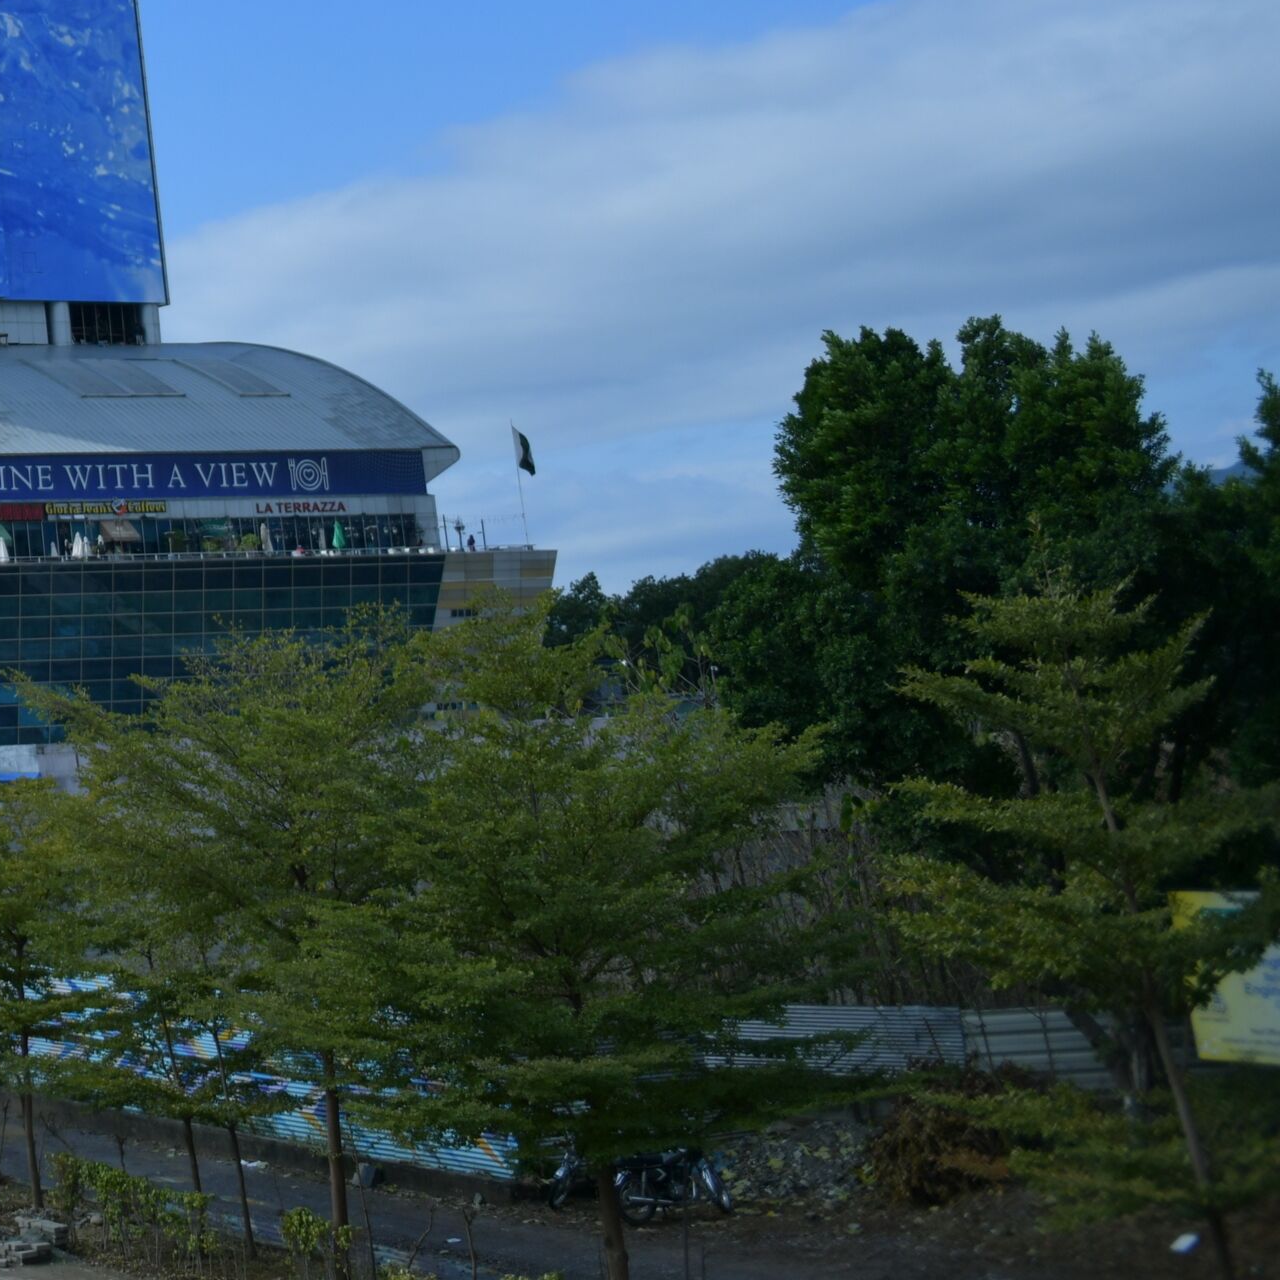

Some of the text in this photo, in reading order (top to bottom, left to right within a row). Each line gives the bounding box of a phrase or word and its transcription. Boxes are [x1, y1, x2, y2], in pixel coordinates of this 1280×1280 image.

[61, 463, 154, 492] WITH
[168, 463, 188, 489] A
[193, 460, 279, 489] VIEW
[255, 501, 347, 514] LA TERRAZZA
